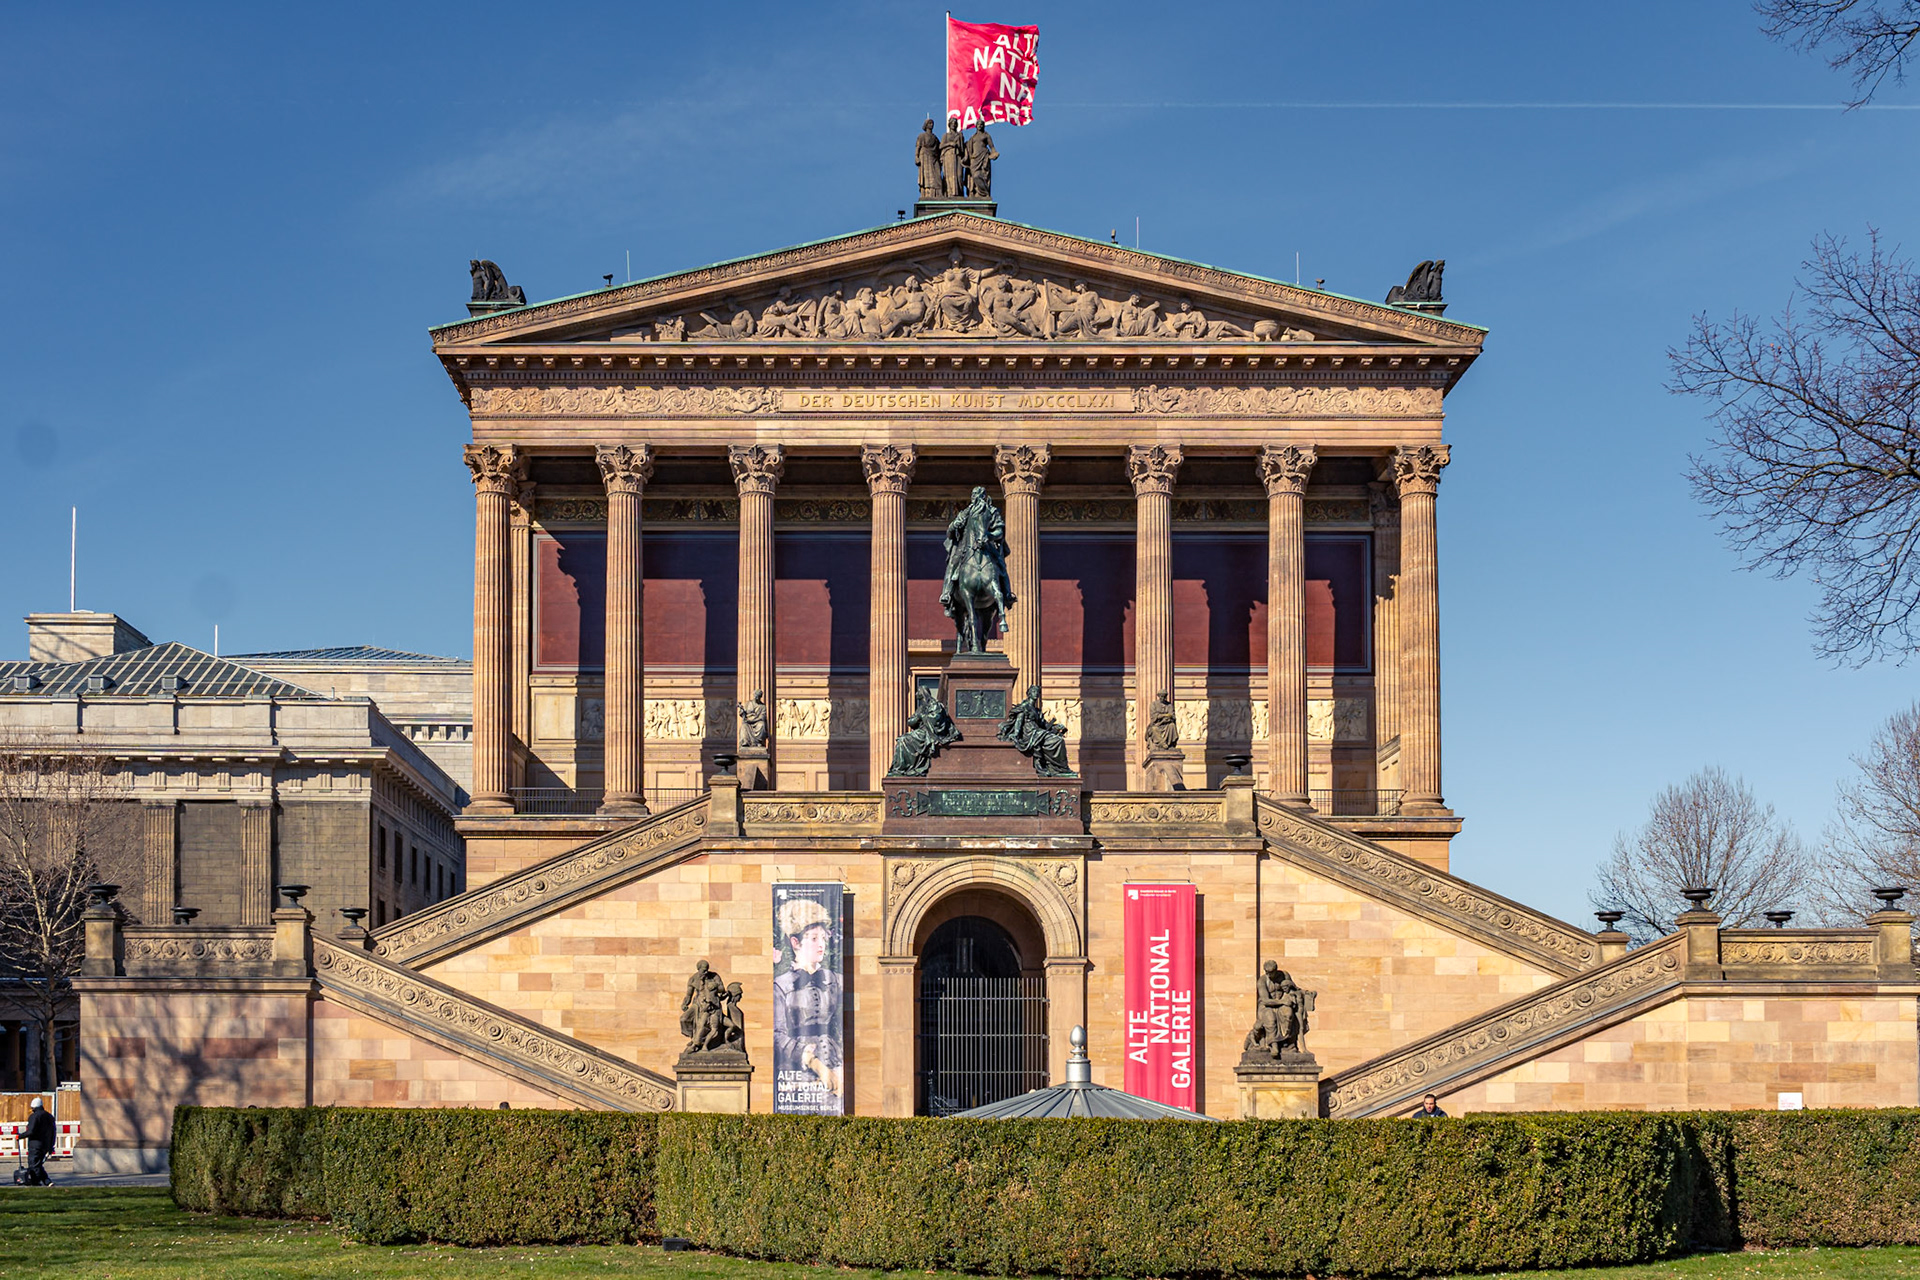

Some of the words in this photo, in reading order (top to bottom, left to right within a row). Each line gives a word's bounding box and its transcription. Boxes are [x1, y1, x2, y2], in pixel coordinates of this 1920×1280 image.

[799, 394, 833, 408] DER
[842, 394, 941, 408] DEUTSCHEN
[950, 394, 1005, 408] KUNST
[1017, 394, 1115, 408] MDCCCLXXI
[1150, 929, 1170, 1044] NATIONAL
[1129, 1010, 1148, 1064] ALTE
[1172, 990, 1191, 1089] GALERIE
[778, 1070, 802, 1080] ALTE
[778, 1082, 830, 1092] NATIONAL
[778, 1093, 822, 1102] GALERIE
